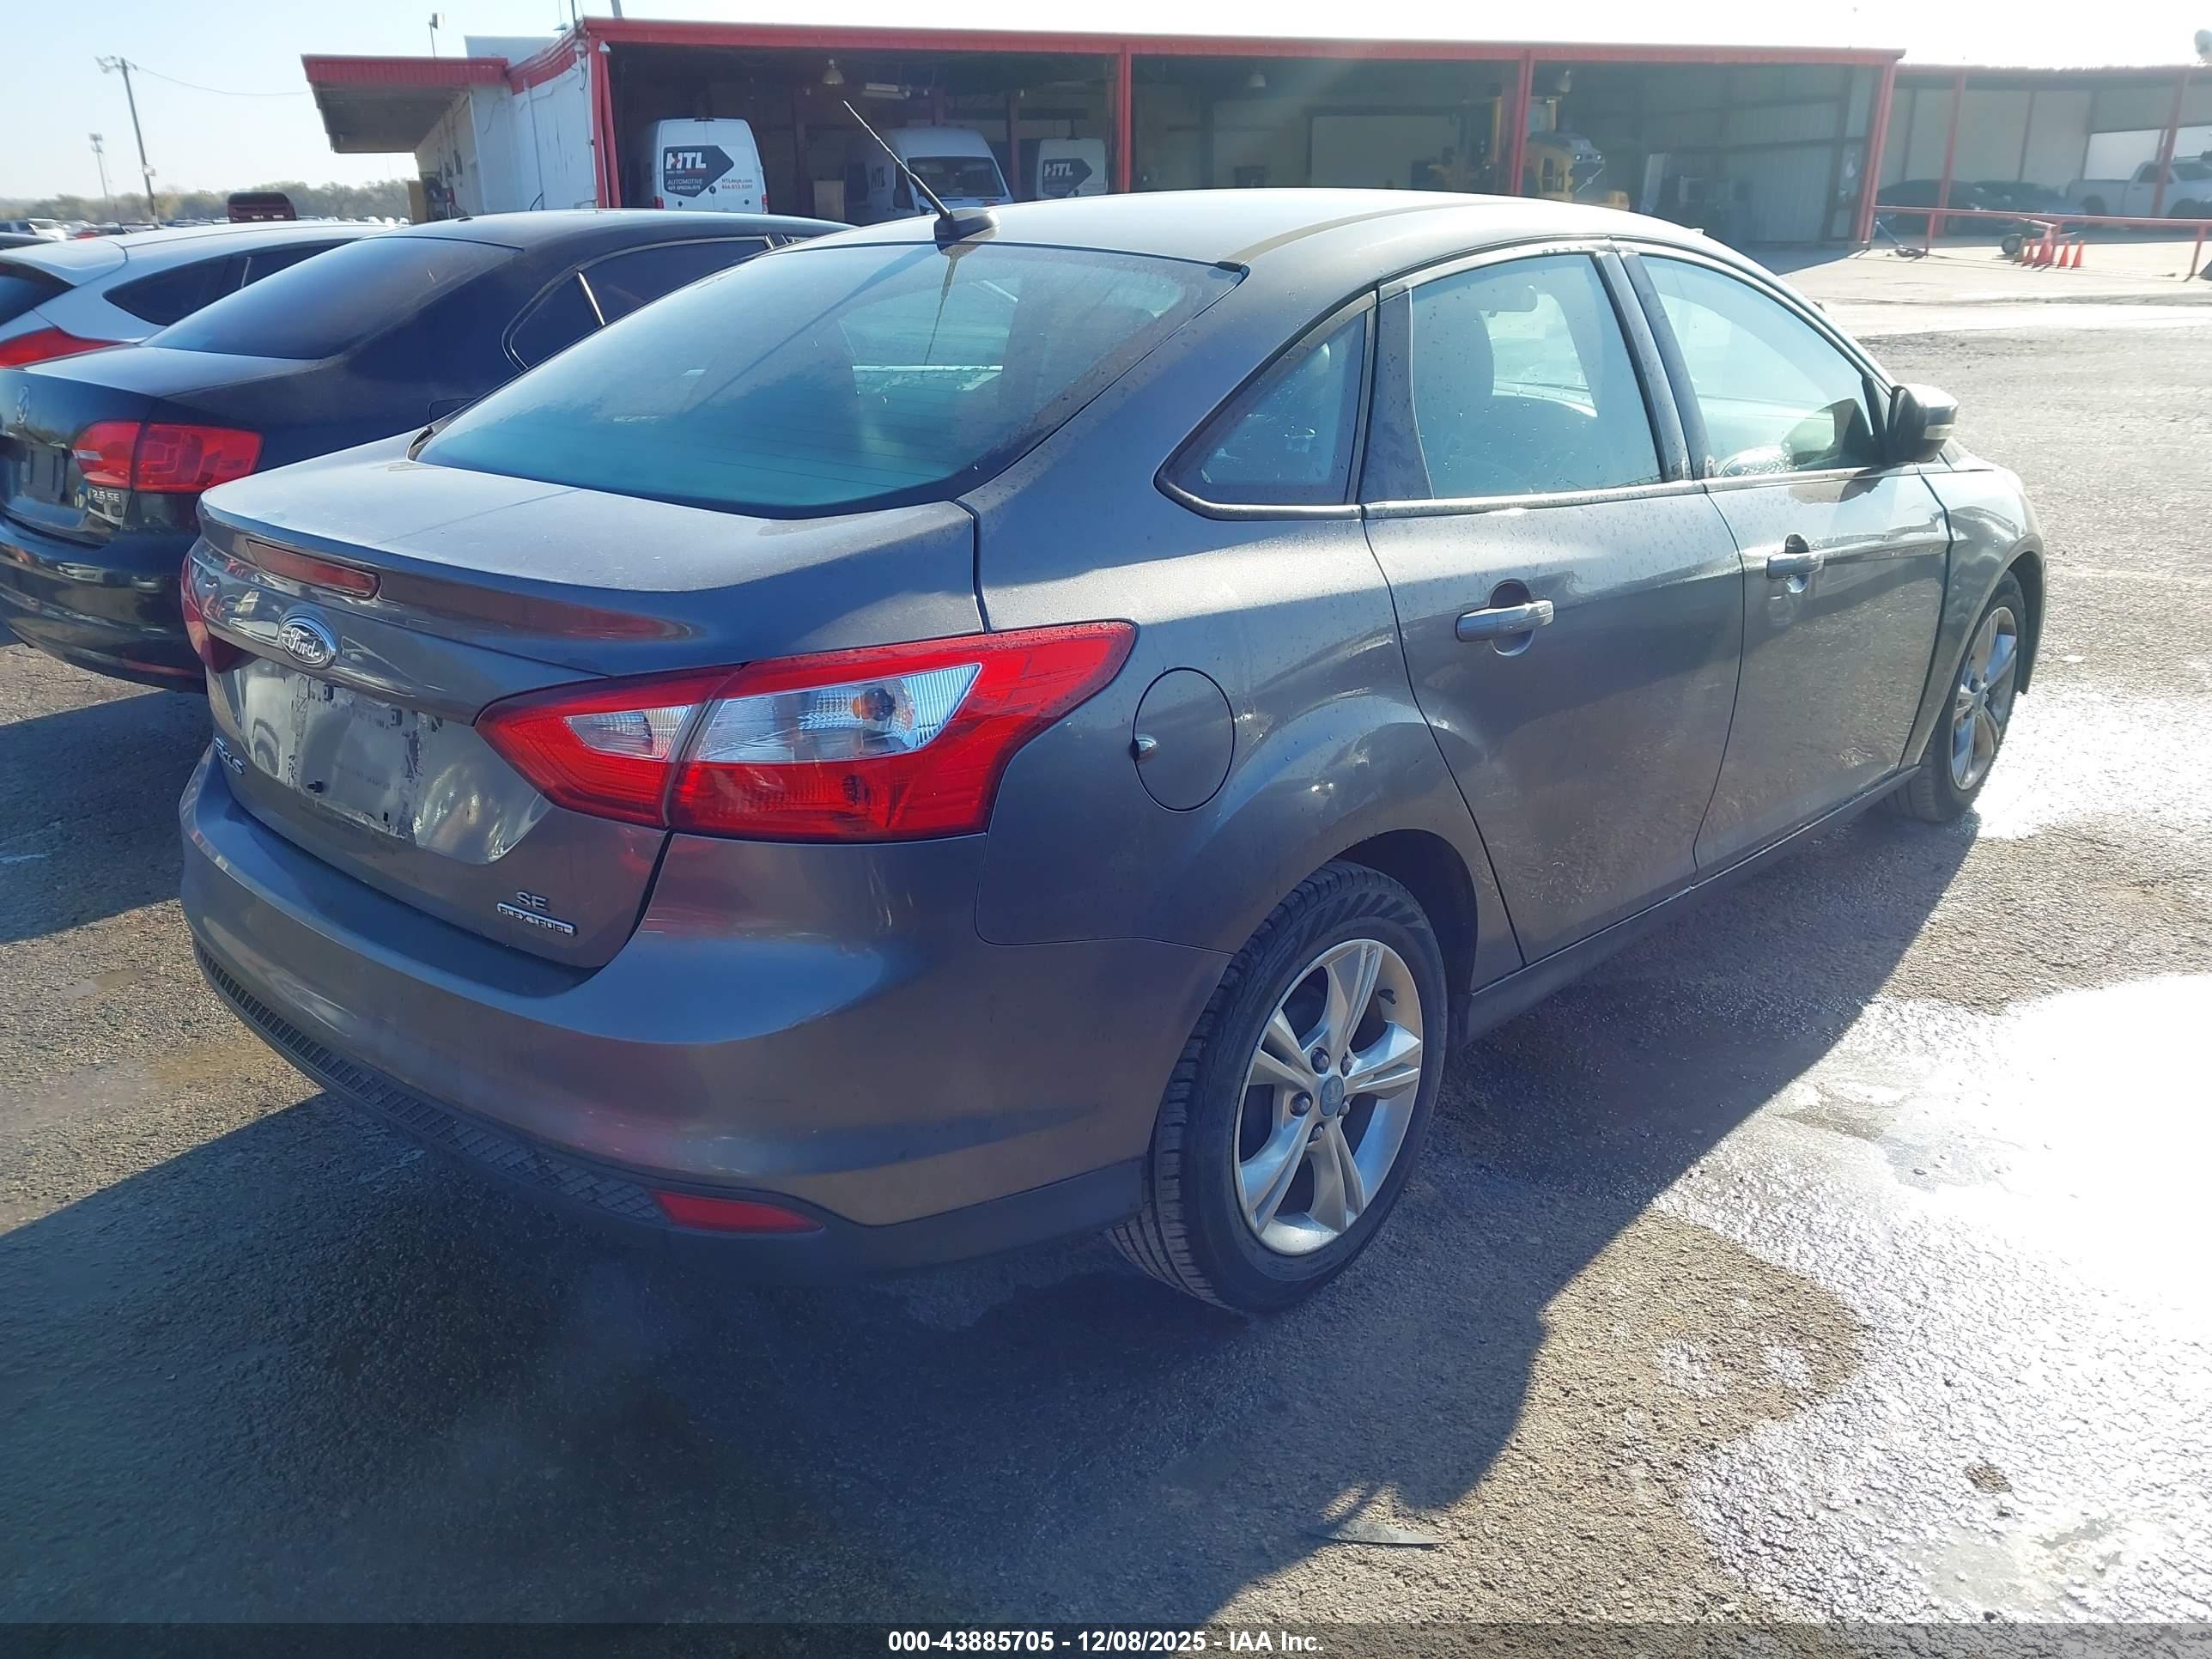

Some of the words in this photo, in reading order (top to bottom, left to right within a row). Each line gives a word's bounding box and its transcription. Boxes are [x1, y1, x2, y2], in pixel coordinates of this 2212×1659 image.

[665, 152, 707, 169] HTL
[1044, 162, 1073, 177] HTL
[106, 491, 120, 502] SE
[288, 627, 321, 659] Ford
[515, 891, 550, 912] SE
